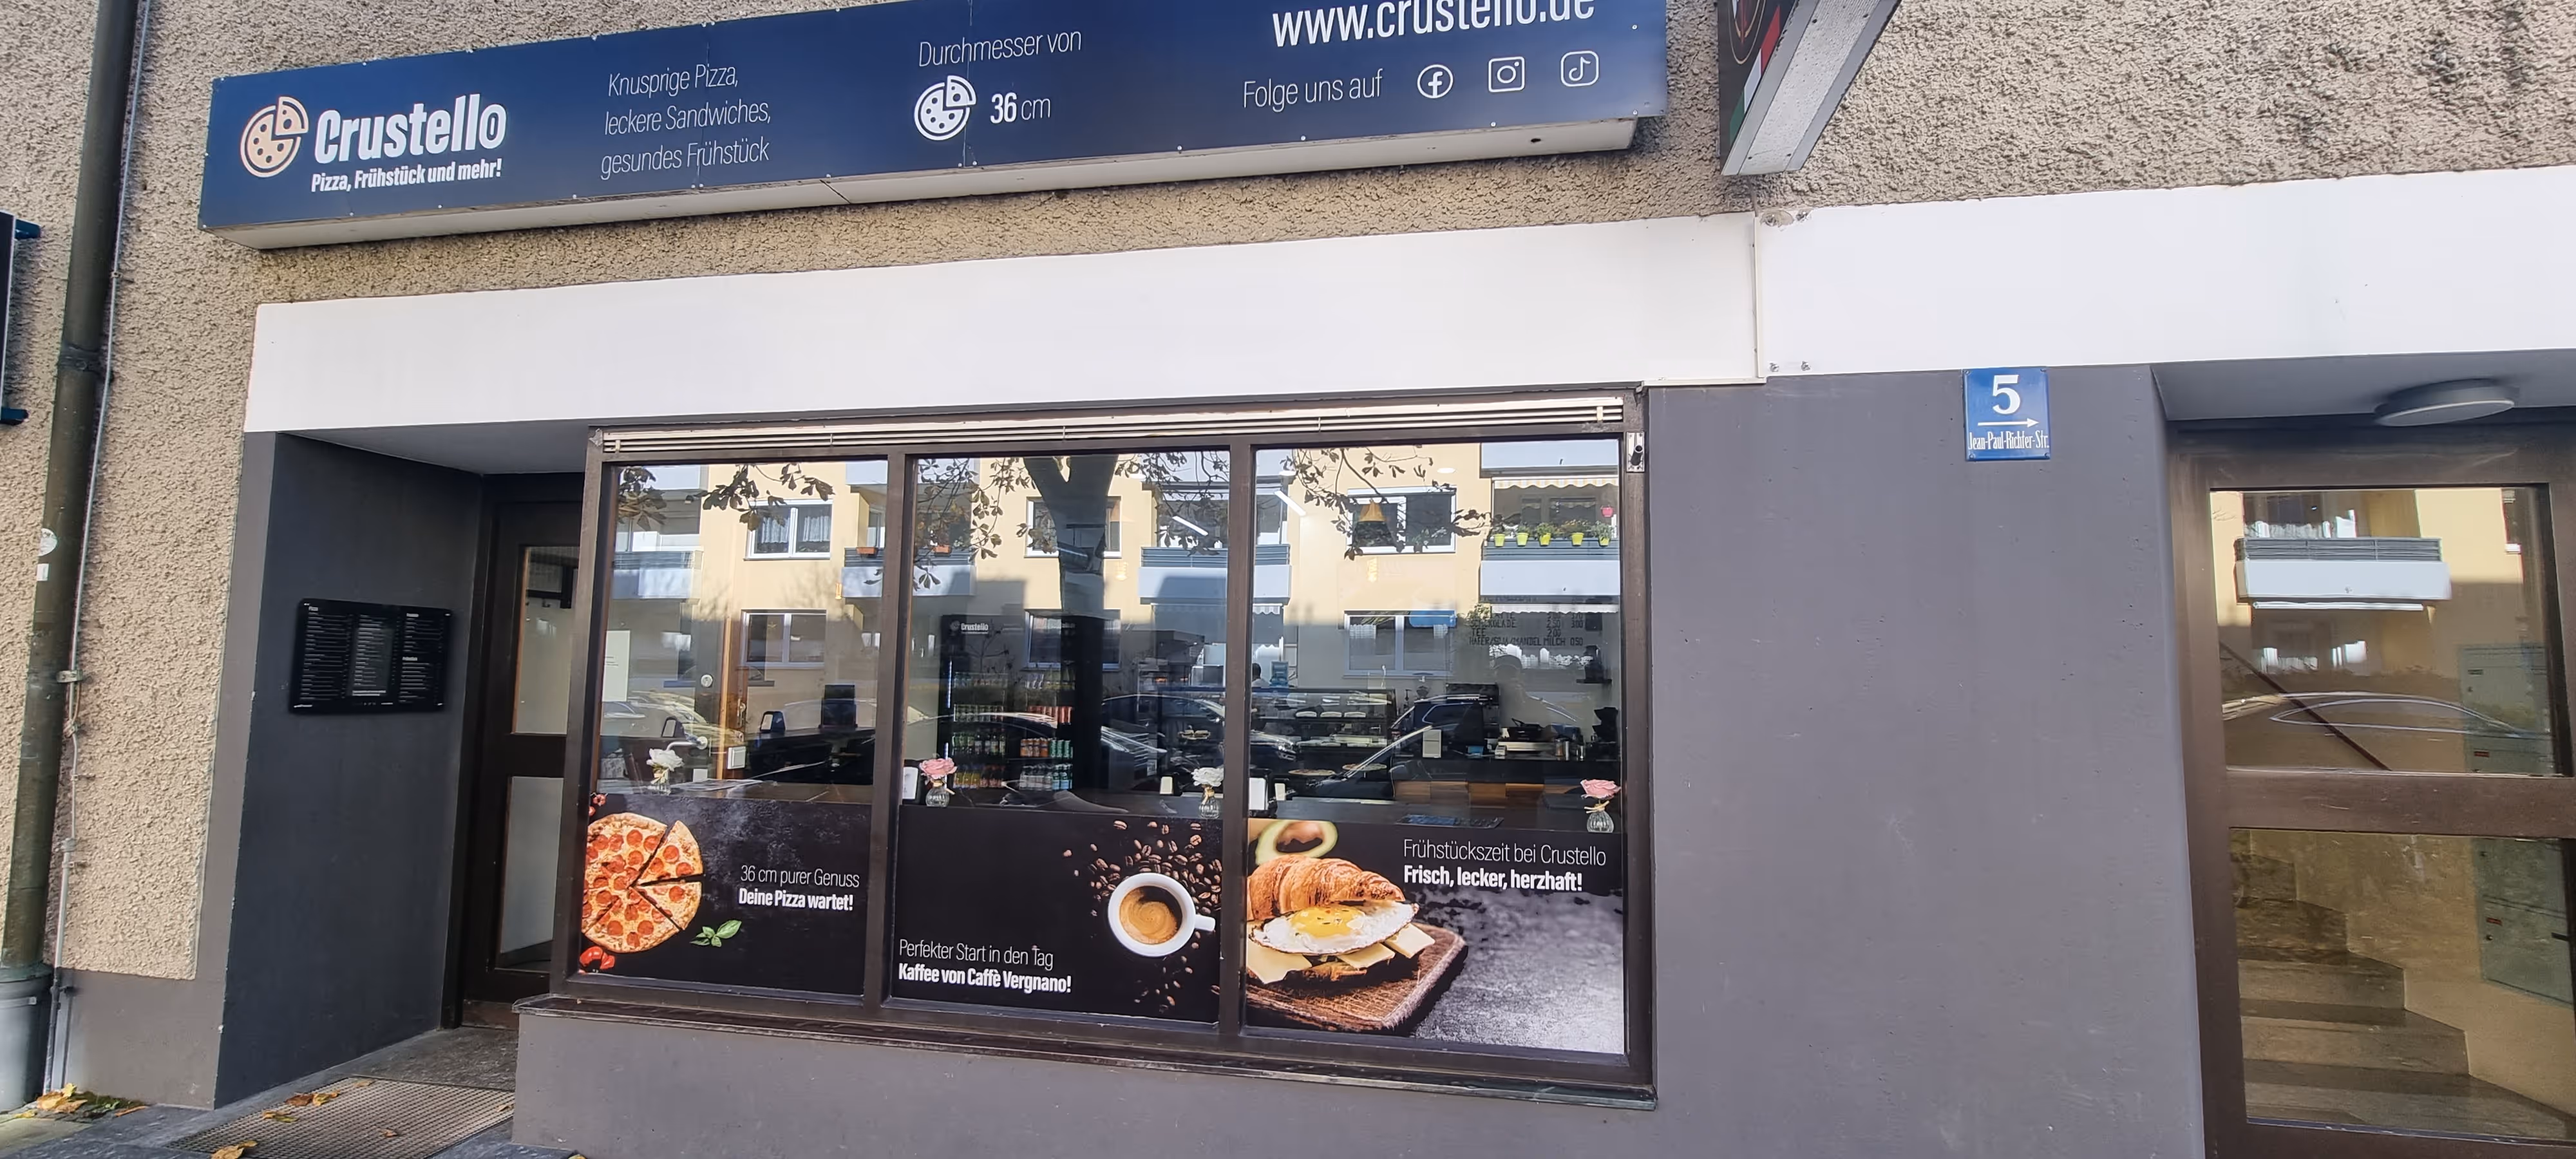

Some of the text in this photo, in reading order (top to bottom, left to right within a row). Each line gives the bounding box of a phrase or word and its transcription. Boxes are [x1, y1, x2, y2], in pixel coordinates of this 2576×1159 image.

[918, 31, 1082, 67] Durchmesser von
[608, 63, 739, 99] Knusprige Pizza,
[1243, 68, 1383, 113] Folge uns auf
[605, 99, 771, 135] leckere Sandwiches,
[990, 91, 1052, 124] 36 cm
[314, 93, 507, 164] Crustello
[600, 136, 770, 181] gesundes Frühstück
[310, 158, 503, 193] Pizza, Frühstück und mehr!
[1992, 374, 2021, 415] 5
[1967, 429, 2050, 450] Jean-Paul-Richter-Str.
[961, 622, 989, 631] Crustello
[1403, 838, 1607, 867] Frühstückszeit bei Crustello
[740, 865, 860, 888] 36 cm purer Genuss
[1404, 864, 1583, 892] Frisch, lecker, herzhaft!
[739, 887, 854, 911] Deine Pizza wartet!
[899, 938, 1054, 971] Perfekter Start in den Tag
[898, 963, 1072, 994] Kaffee von Caffè Vergnano!
